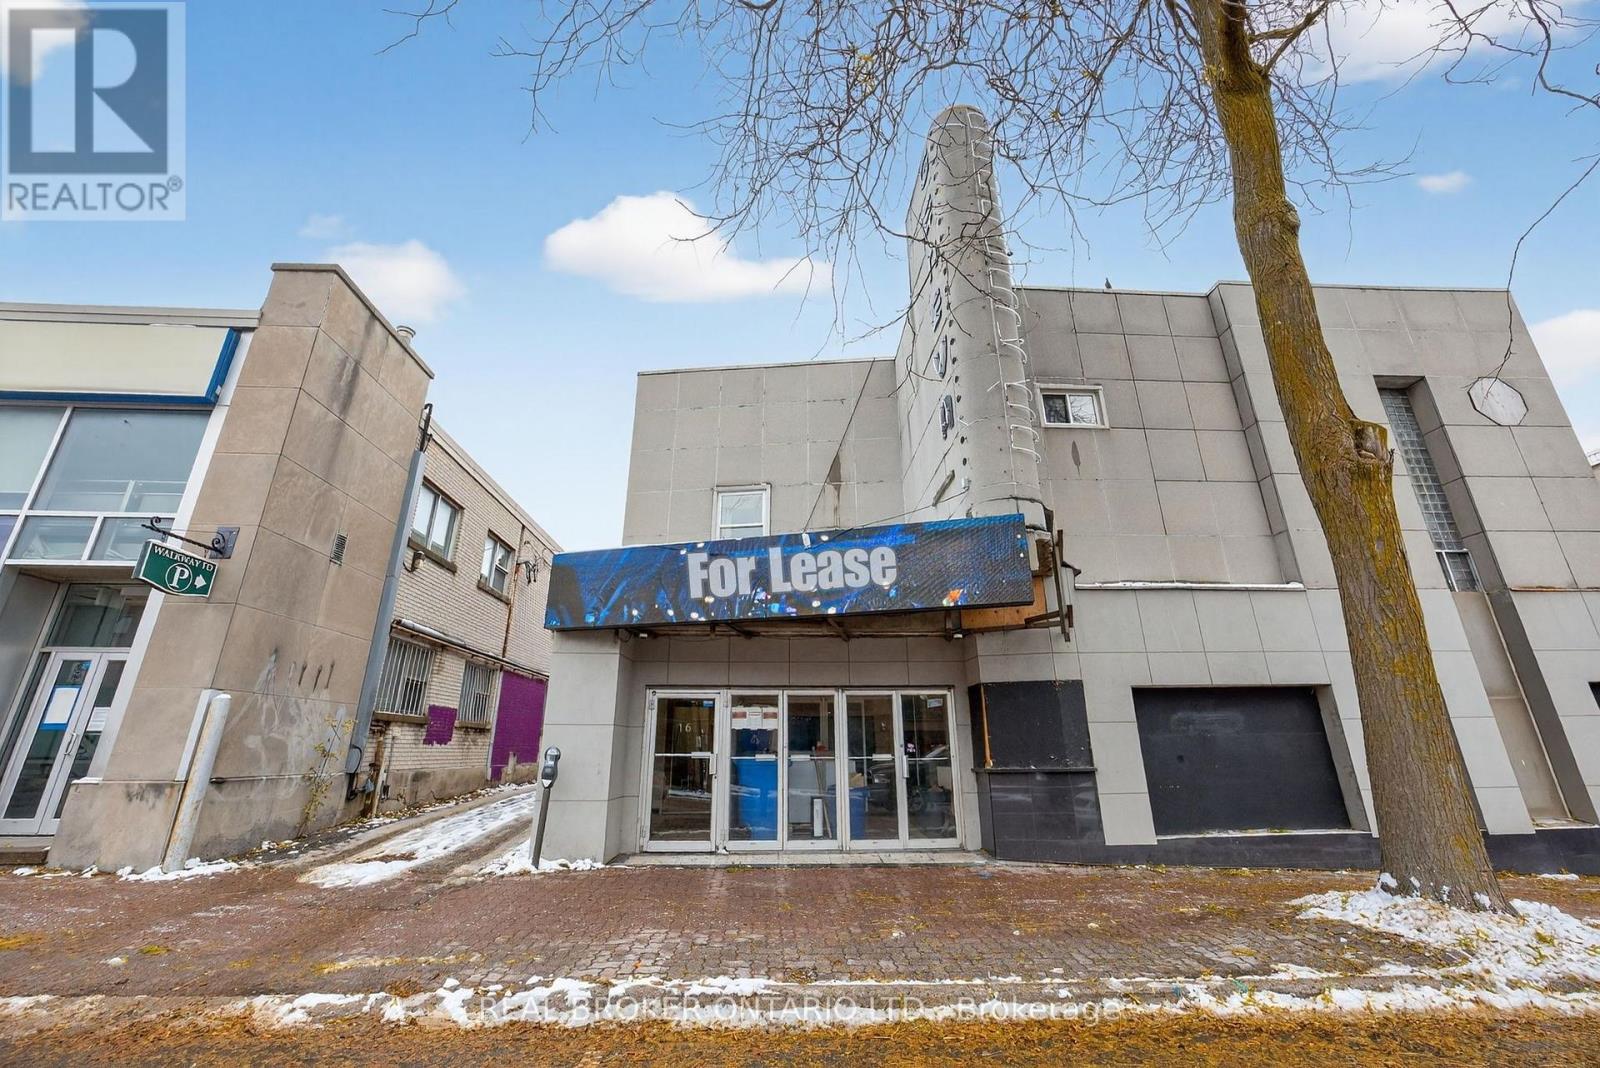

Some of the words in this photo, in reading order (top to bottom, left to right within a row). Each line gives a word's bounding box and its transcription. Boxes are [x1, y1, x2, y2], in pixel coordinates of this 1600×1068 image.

[154, 545, 201, 568] WALKWAY
[202, 562, 214, 572] TO
[169, 564, 190, 589] P
[687, 552, 756, 599] For
[768, 546, 897, 593] Lease
